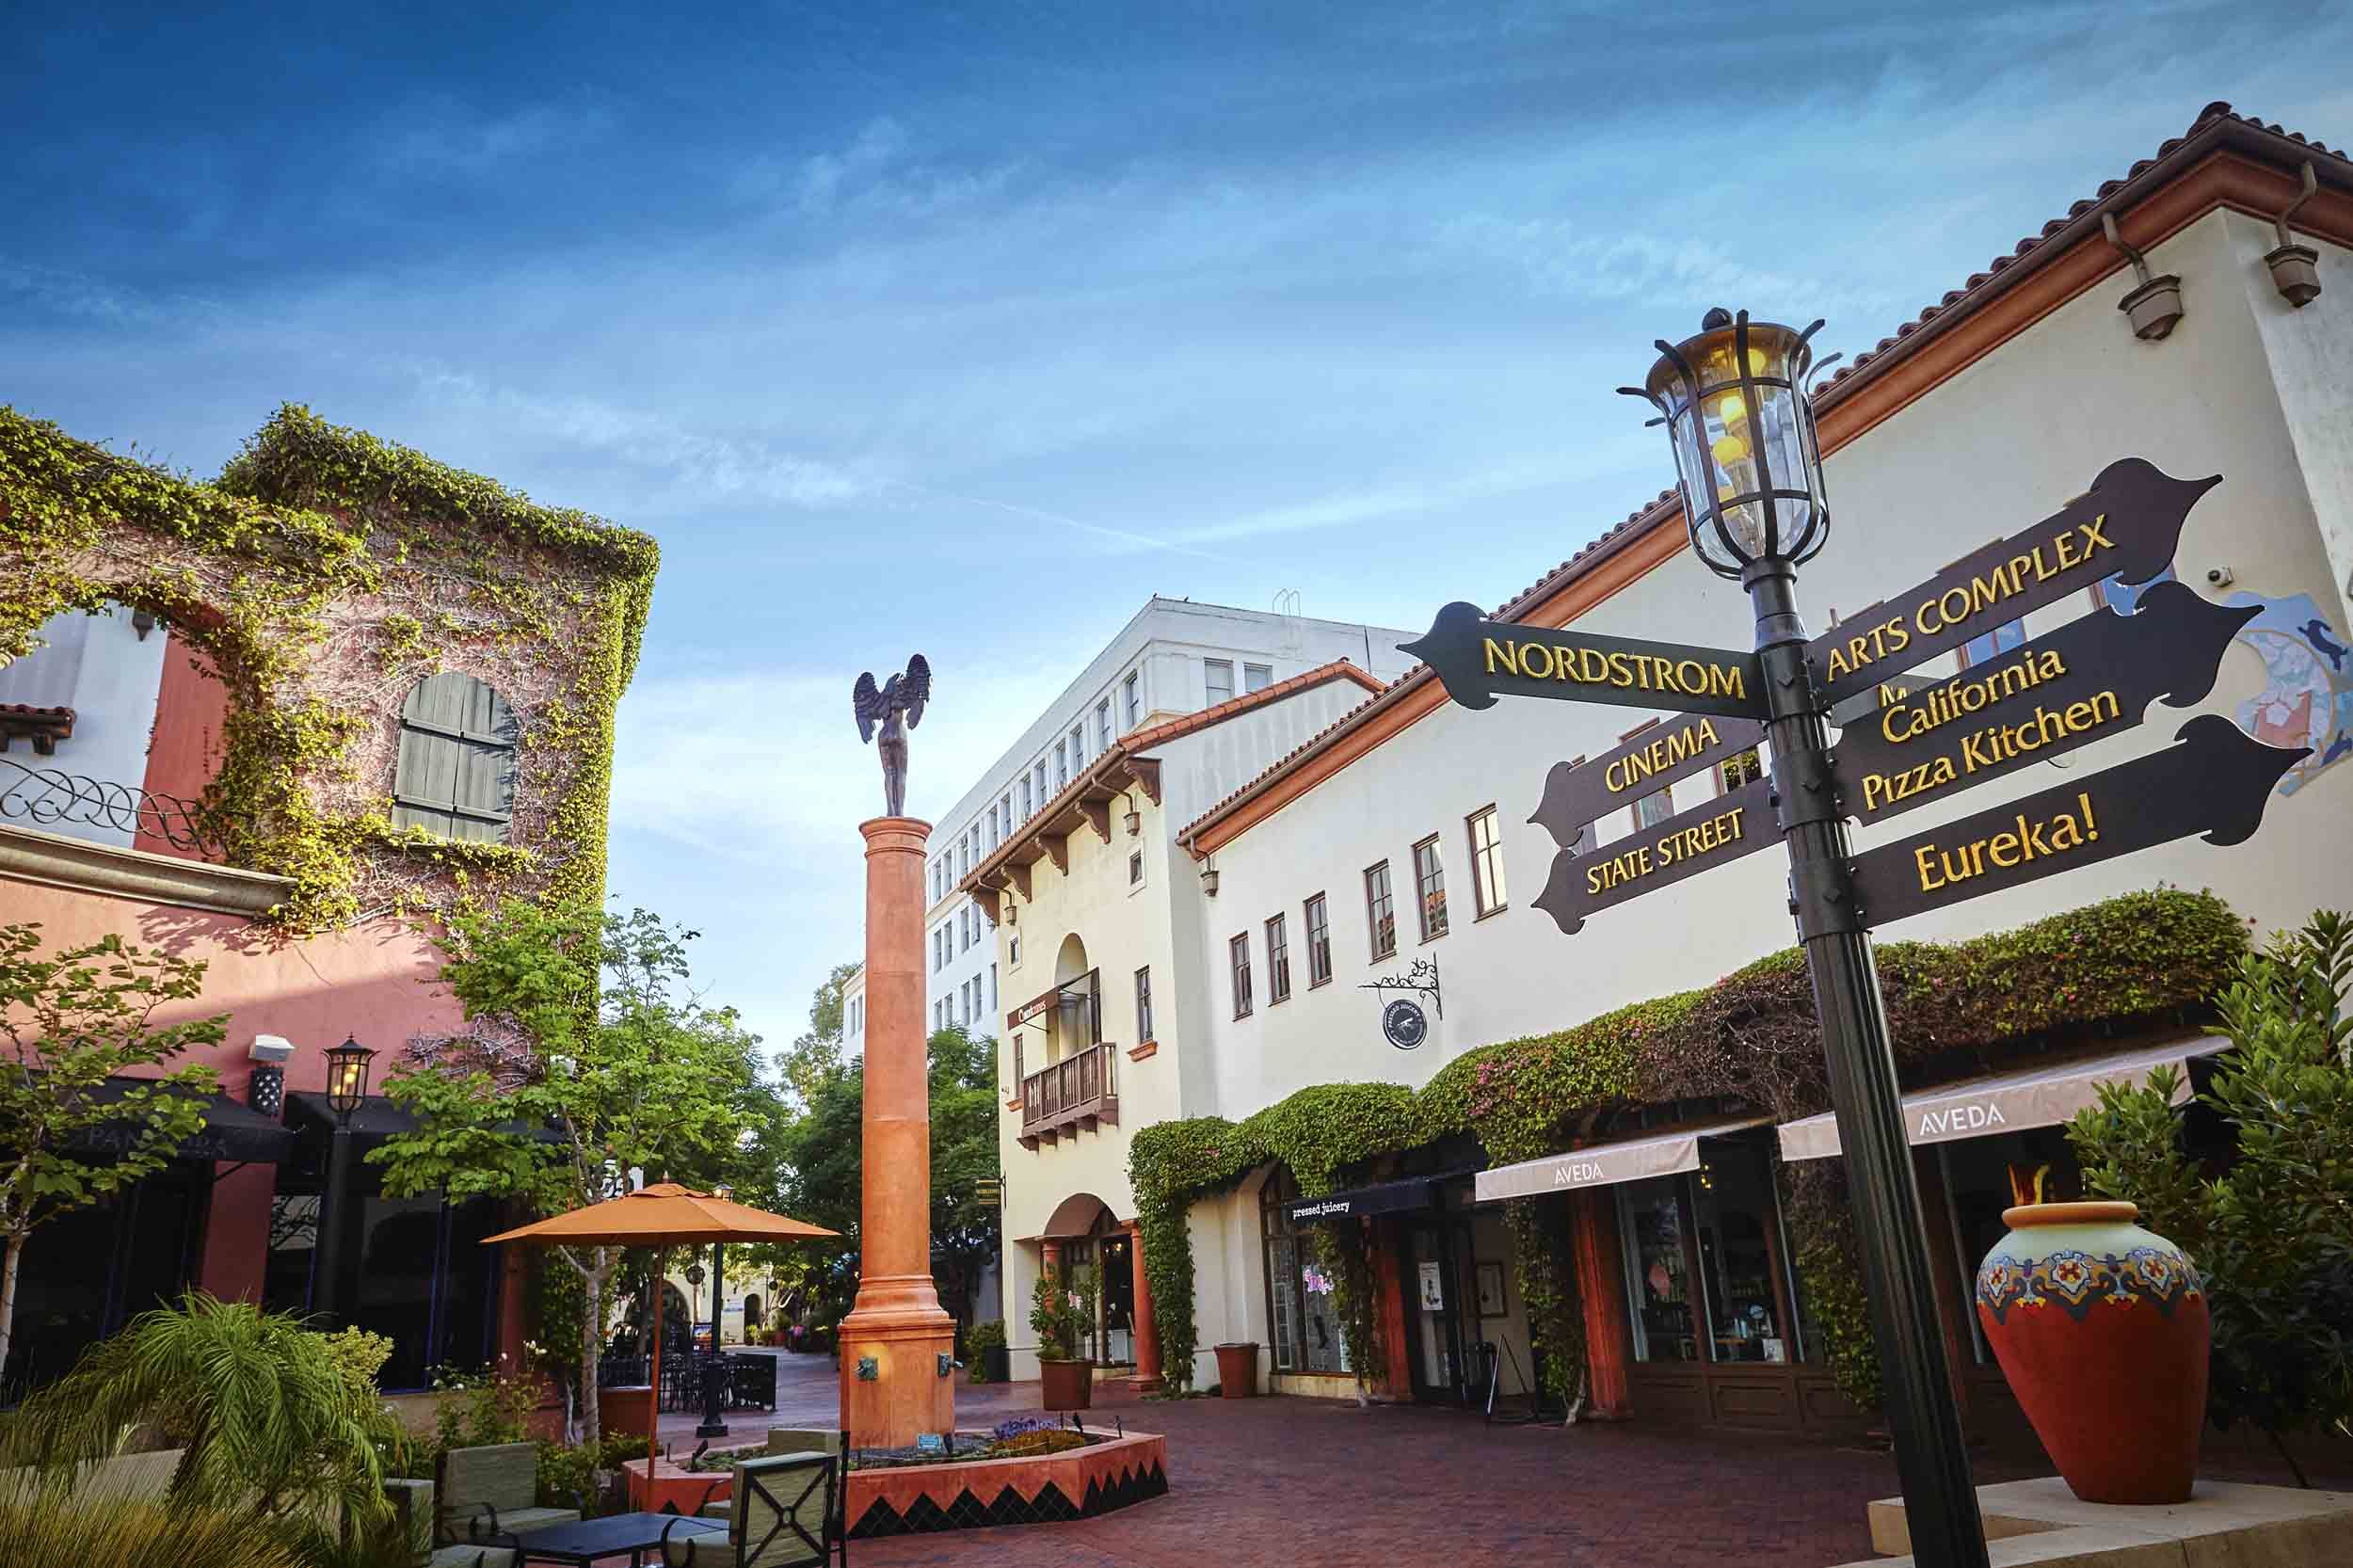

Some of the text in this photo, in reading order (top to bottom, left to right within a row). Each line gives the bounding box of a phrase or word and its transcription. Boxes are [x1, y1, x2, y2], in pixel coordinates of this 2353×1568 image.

[1826, 515, 2115, 683] ARTS COMPLEX
[1483, 638, 1747, 701] NORDSTROM
[1882, 649, 2068, 744] California
[1605, 718, 1721, 793] CINEMA
[1861, 690, 2121, 812] Pizza Kitchen
[1587, 808, 1744, 895] STATE STREET
[1914, 792, 2100, 893] Eureka!
[1920, 1102, 2006, 1136] AVEDA
[1292, 1201, 1350, 1220] pressed juicery
[1555, 1160, 1605, 1184] AVEDA
